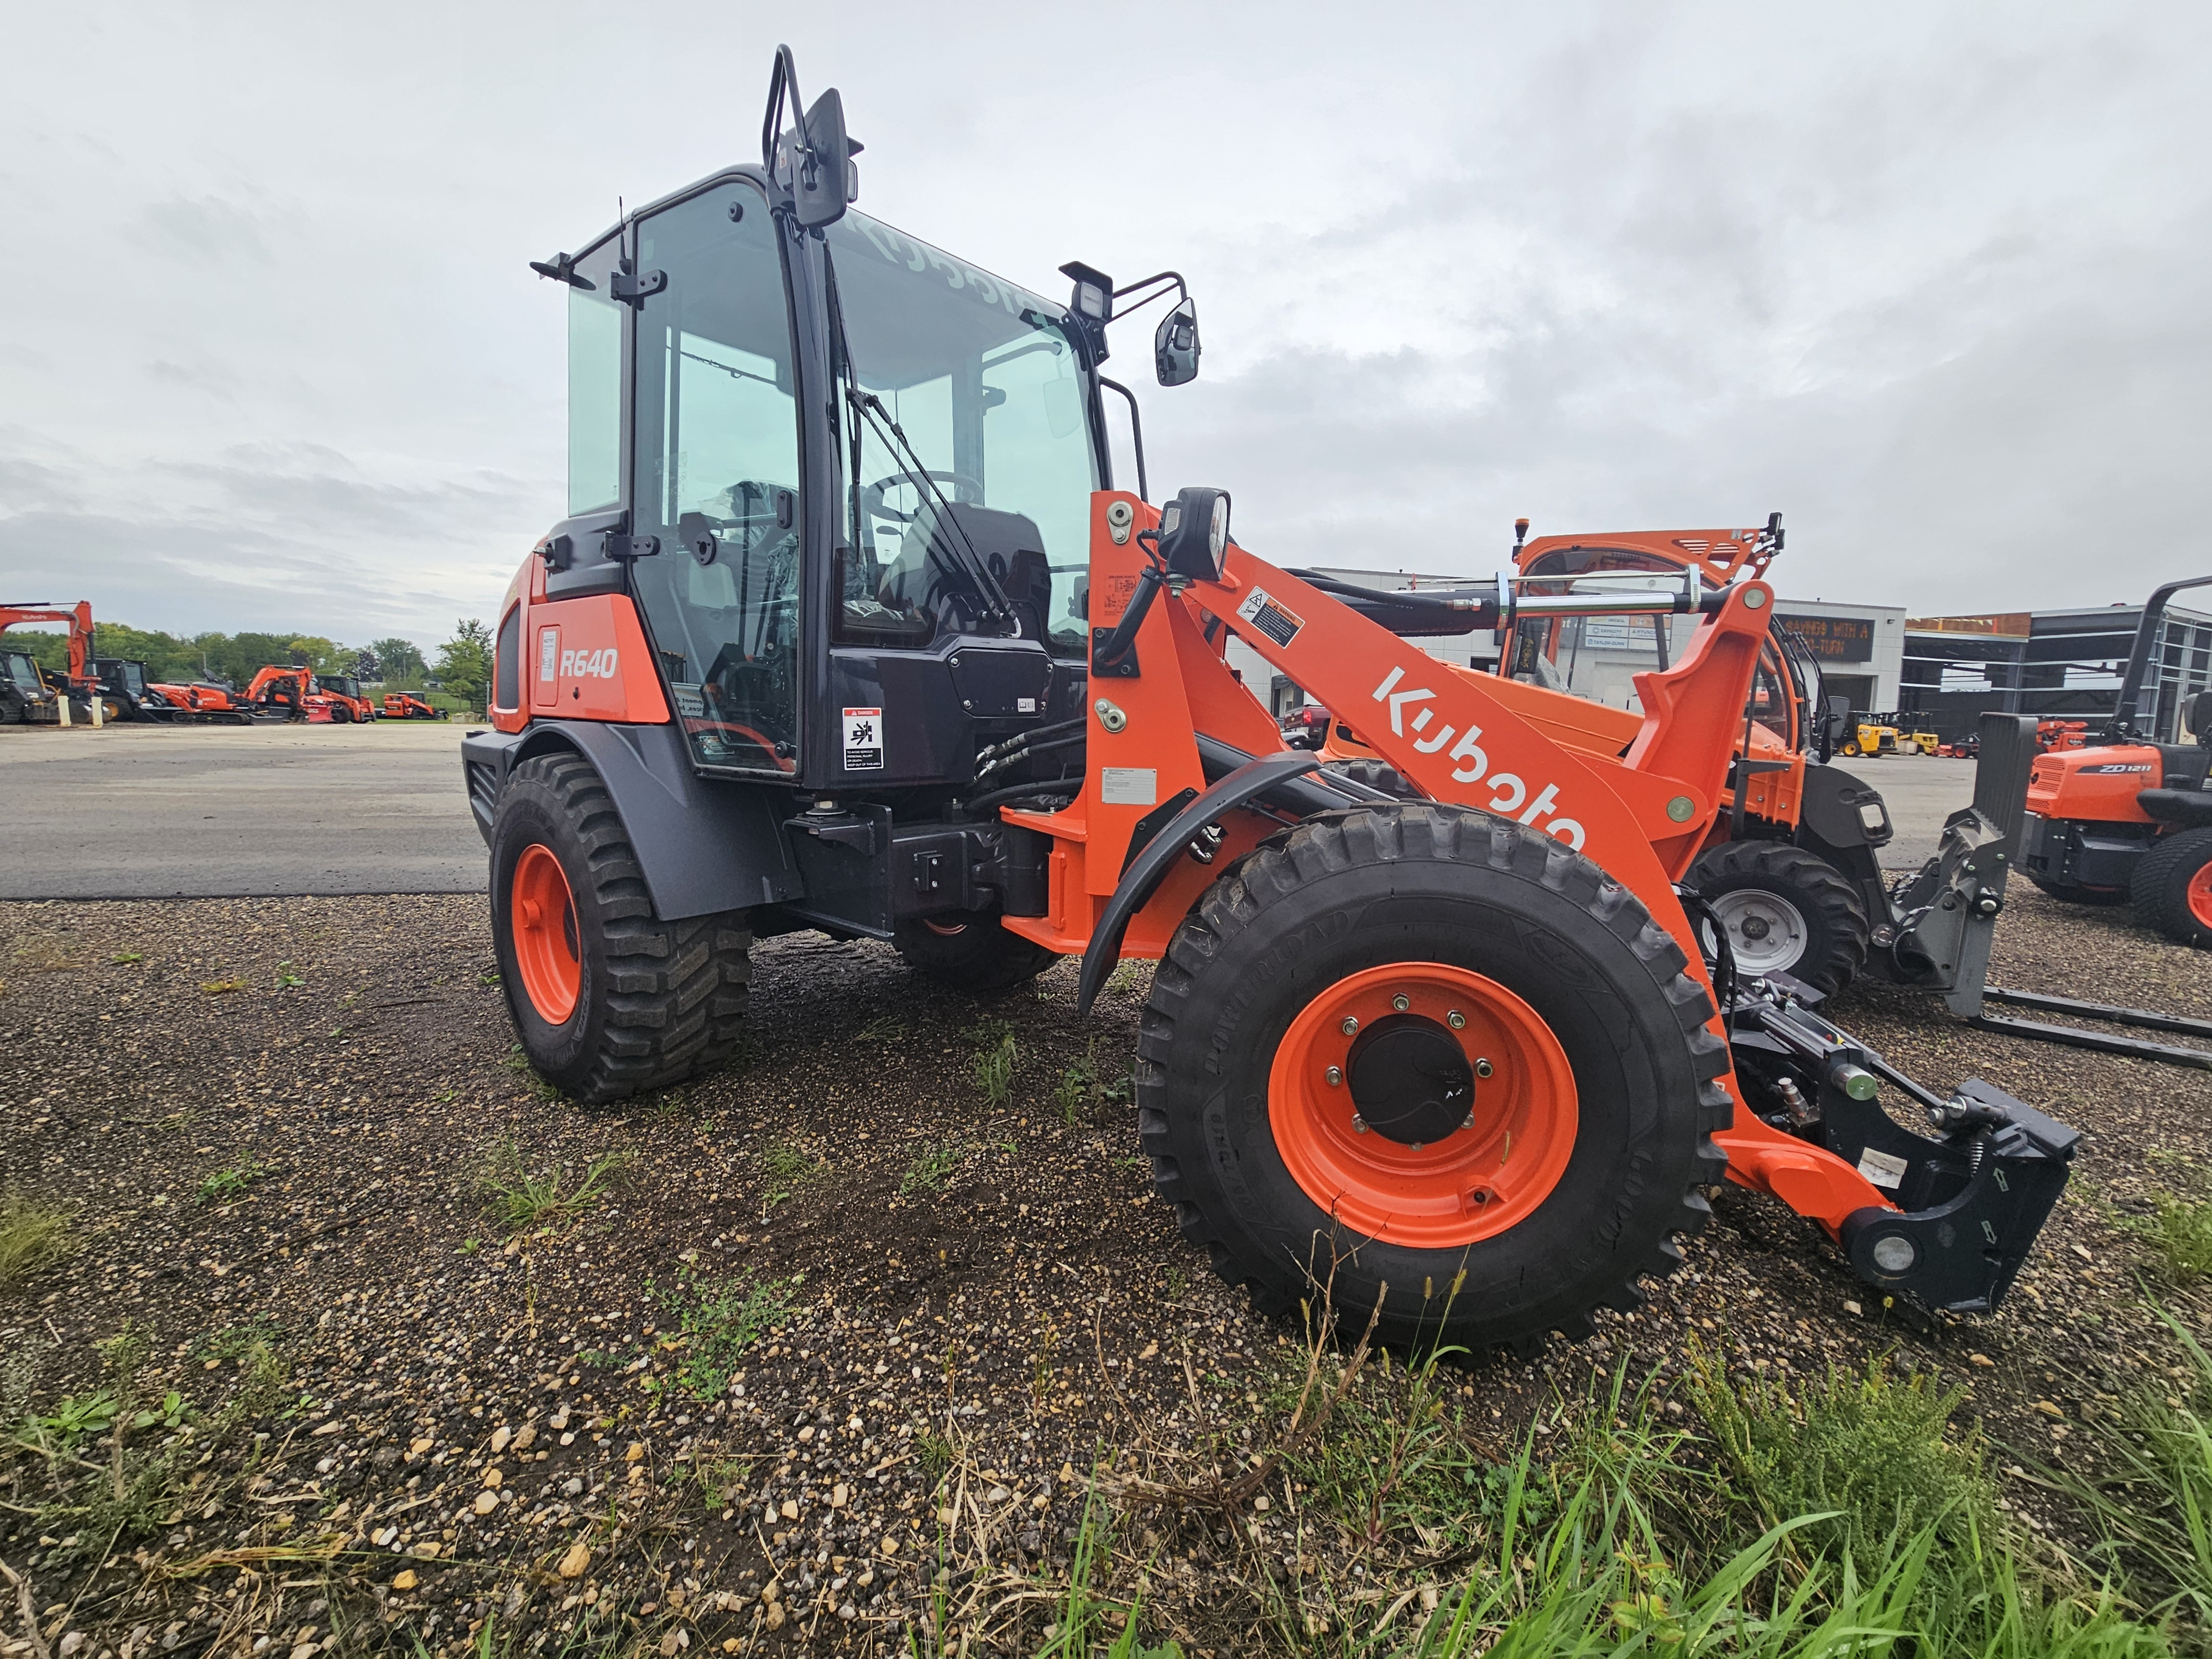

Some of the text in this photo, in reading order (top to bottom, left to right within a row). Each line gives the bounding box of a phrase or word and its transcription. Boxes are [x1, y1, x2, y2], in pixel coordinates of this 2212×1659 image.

[1279, 607, 1296, 622] WARNING
[1833, 623, 1856, 638] WITH
[1860, 624, 1868, 639] A
[559, 648, 618, 679] R640
[1372, 665, 1586, 852] Kubota
